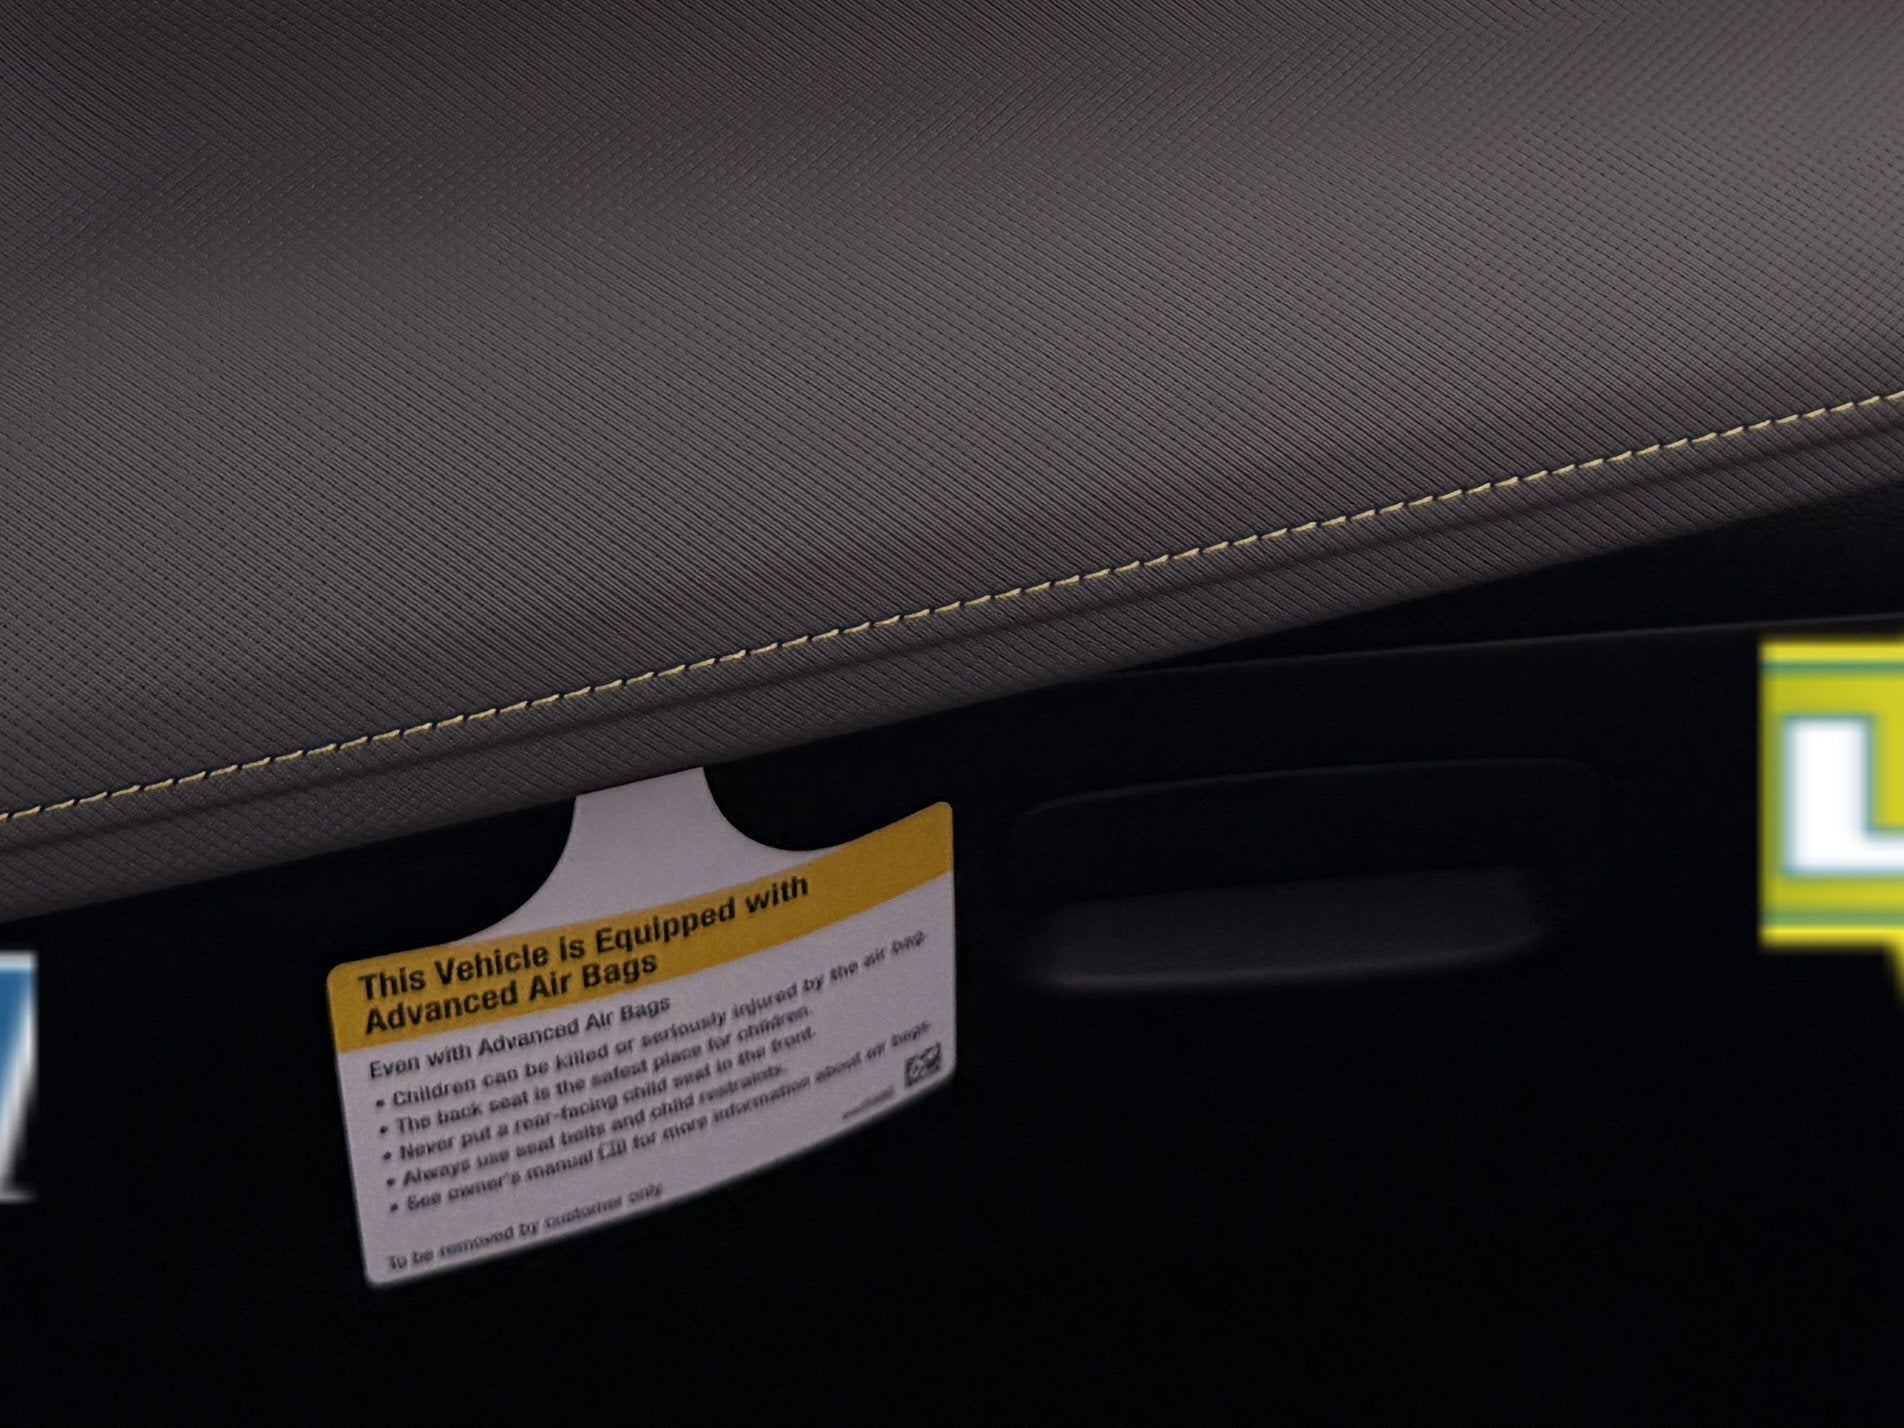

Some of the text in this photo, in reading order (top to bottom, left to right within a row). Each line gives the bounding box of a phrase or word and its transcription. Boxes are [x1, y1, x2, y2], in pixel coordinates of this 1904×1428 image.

[359, 877, 808, 1001] This Vehicle is Equipped with
[365, 952, 658, 1035] Advanced Air Bags
[393, 1078, 475, 1107] Children
[482, 1068, 518, 1088] can
[525, 1059, 548, 1077] be
[555, 1044, 609, 1070] killed
[732, 983, 797, 1018] injured
[802, 974, 826, 993] by
[829, 961, 858, 982] the
[370, 998, 671, 1079] Even with Advanced Air Bags
[396, 1116, 430, 1135] The
[437, 1100, 482, 1124] back
[489, 1090, 528, 1113] seat
[556, 1076, 585, 1095] the
[591, 1059, 647, 1087] safest
[652, 1044, 702, 1072] place
[399, 1138, 454, 1160] Never
[461, 1128, 491, 1148] put
[497, 1123, 509, 1136] a
[622, 1080, 667, 1104] child
[402, 1160, 470, 1186] Always
[611, 1110, 645, 1131] and
[650, 1095, 695, 1119] child
[406, 1193, 442, 1211] See
